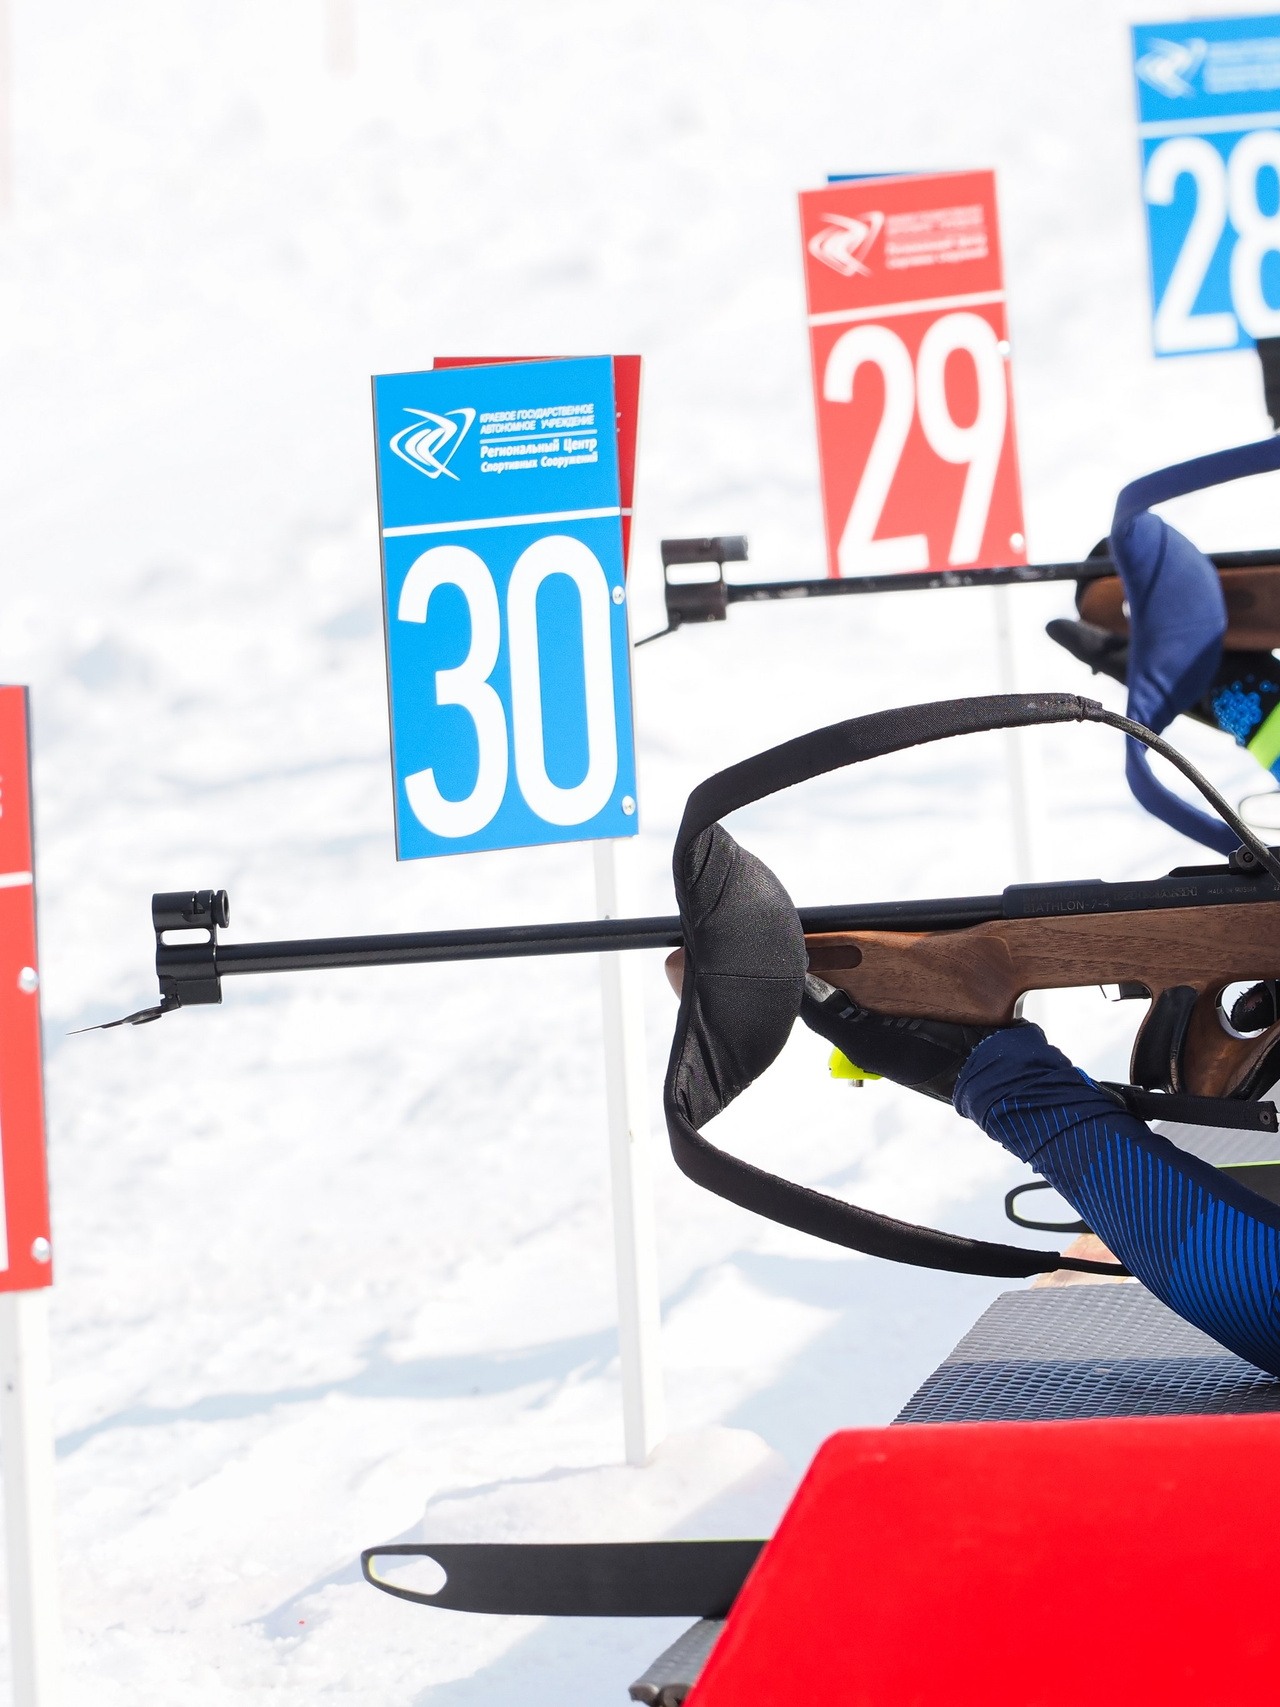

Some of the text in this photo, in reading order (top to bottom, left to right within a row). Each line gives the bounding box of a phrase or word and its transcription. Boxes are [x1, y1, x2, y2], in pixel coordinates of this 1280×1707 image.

[480, 403, 594, 423] КРАЕВОЕ ГОСУДАРСТВЕННОЕ
[480, 414, 595, 434] АВТОНОМНОЕ УЧРЕЖДЕНИЕ
[480, 438, 598, 459] Региональный Центр
[824, 312, 1008, 578] 29
[480, 451, 598, 474] Спортивных Сооружений
[398, 534, 619, 839] 30
[1022, 898, 1111, 914] BIATHLON-7-4
